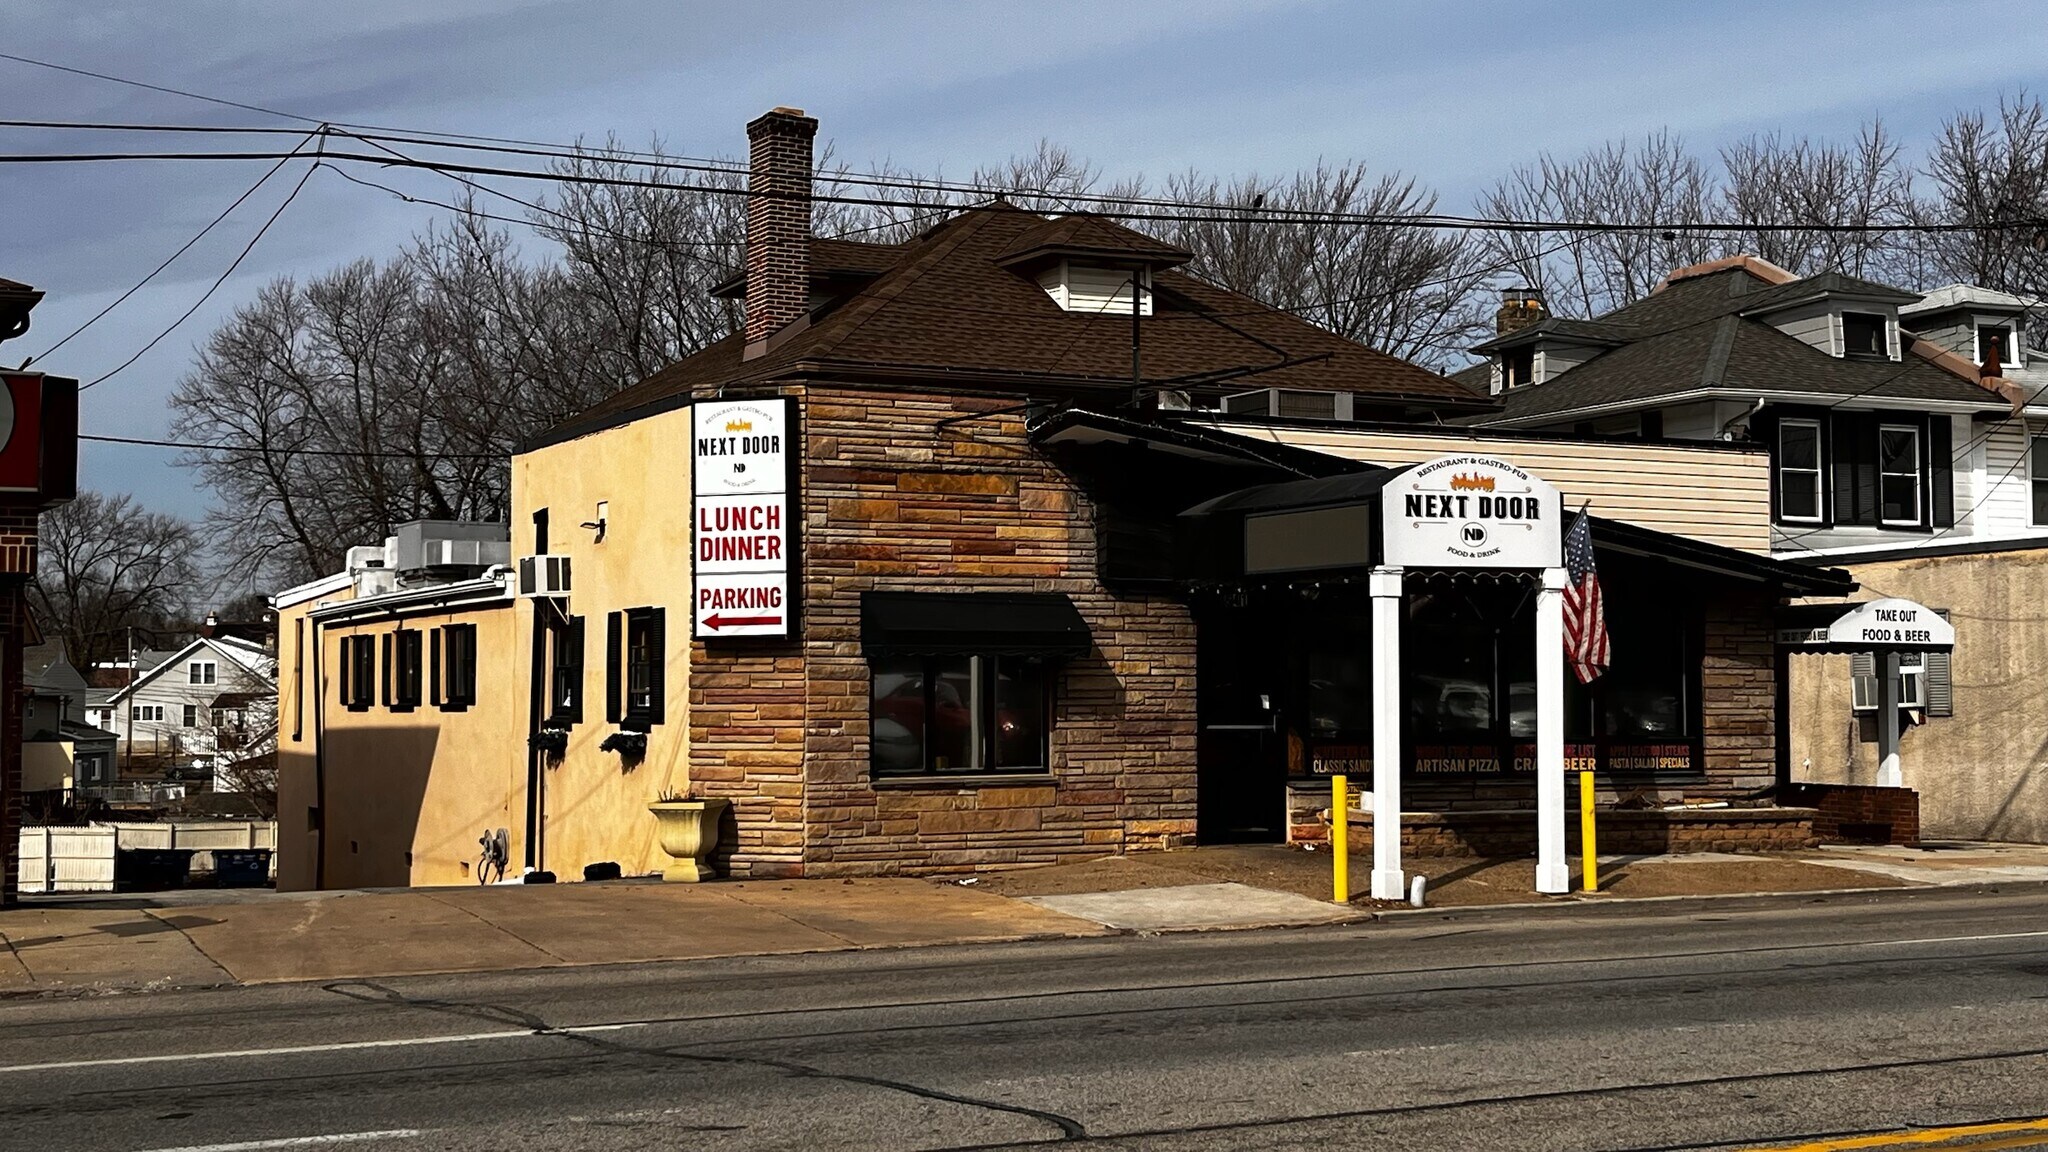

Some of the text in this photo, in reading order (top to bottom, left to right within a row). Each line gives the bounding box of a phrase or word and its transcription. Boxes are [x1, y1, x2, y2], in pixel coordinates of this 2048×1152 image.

[698, 435, 780, 456] NEXT DOOR
[1417, 458, 1469, 477] RESTAURANT
[1405, 494, 1541, 520] NEXT DOOR
[700, 505, 780, 531] LUNCH
[700, 535, 781, 561] DINNER
[1447, 546, 1468, 558] FOOD
[1477, 547, 1501, 558] DRINK
[700, 587, 782, 609] PARKING
[1875, 609, 1917, 622] TAKE OUT
[1862, 628, 1931, 642] FOOD & BEER
[1578, 744, 1596, 757] LIST
[1664, 744, 1690, 756] STEAKS
[1313, 759, 1373, 773] CLASSIC SAND
[1415, 759, 1501, 773] ARTISAN PIZZA
[1564, 757, 1596, 771] BEER
[1609, 757, 1690, 769] PASTA SALAD SPECIALS
